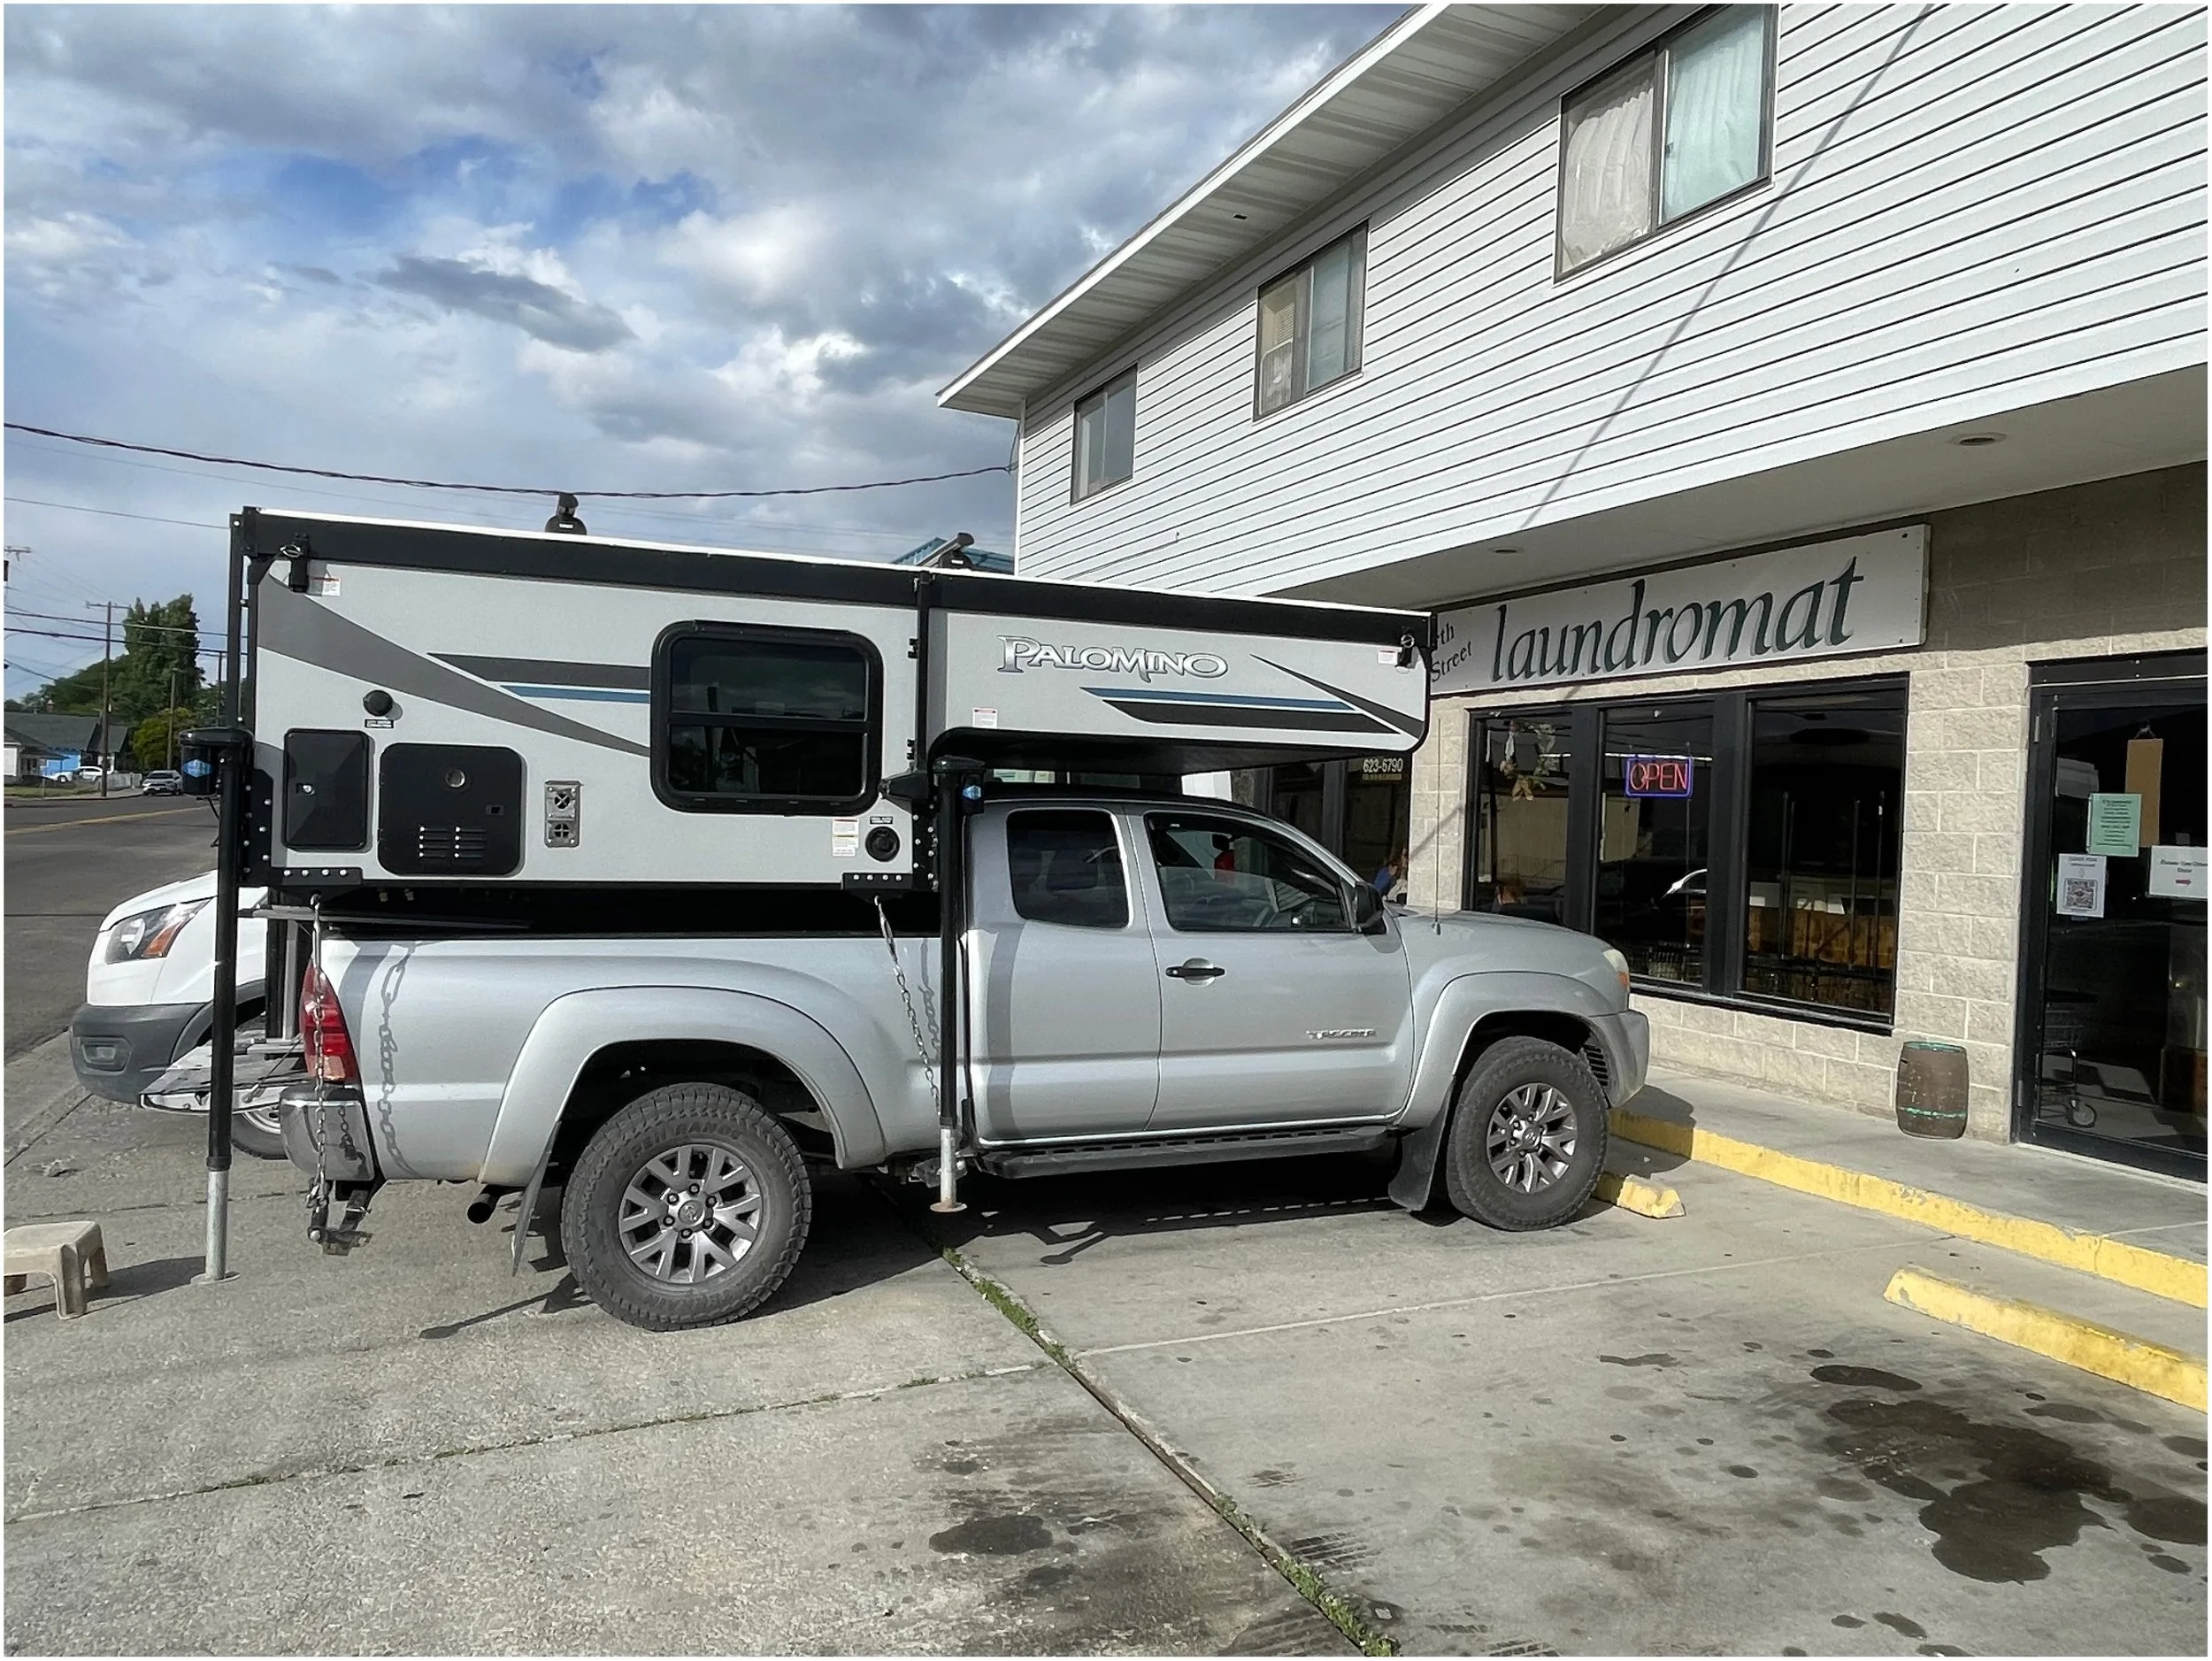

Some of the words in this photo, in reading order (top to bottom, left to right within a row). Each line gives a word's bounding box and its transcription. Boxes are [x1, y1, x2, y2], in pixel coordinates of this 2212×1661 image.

[1491, 556, 1864, 682] laundromat
[1437, 623, 1455, 645] th
[1431, 640, 1472, 682] Street
[1363, 757, 1403, 773] 623-6790
[1630, 762, 1688, 790] OPEN
